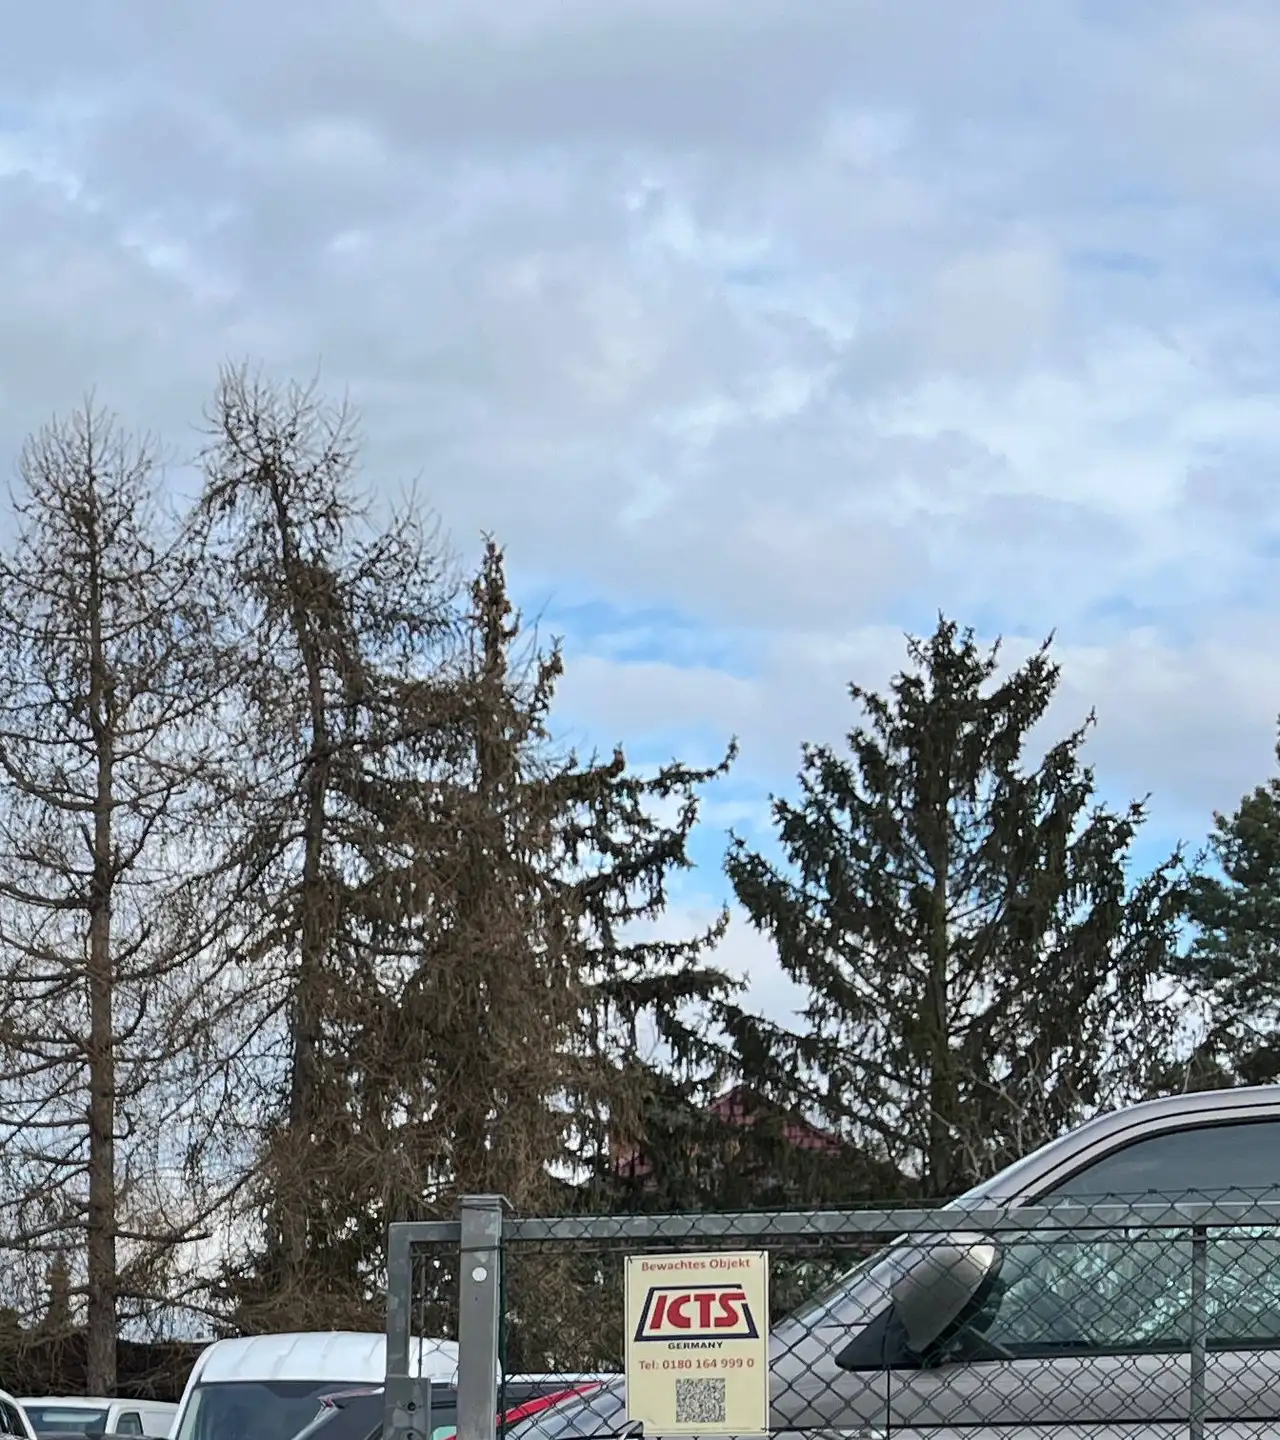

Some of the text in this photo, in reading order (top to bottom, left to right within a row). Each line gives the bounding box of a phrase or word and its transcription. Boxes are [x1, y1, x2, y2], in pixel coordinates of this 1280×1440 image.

[641, 1258, 751, 1272] Bewachtes Objekt
[649, 1292, 746, 1330] ICTS
[667, 1341, 723, 1350] GERMANY
[640, 1358, 755, 1370] Tel: 0180 164 999 0
